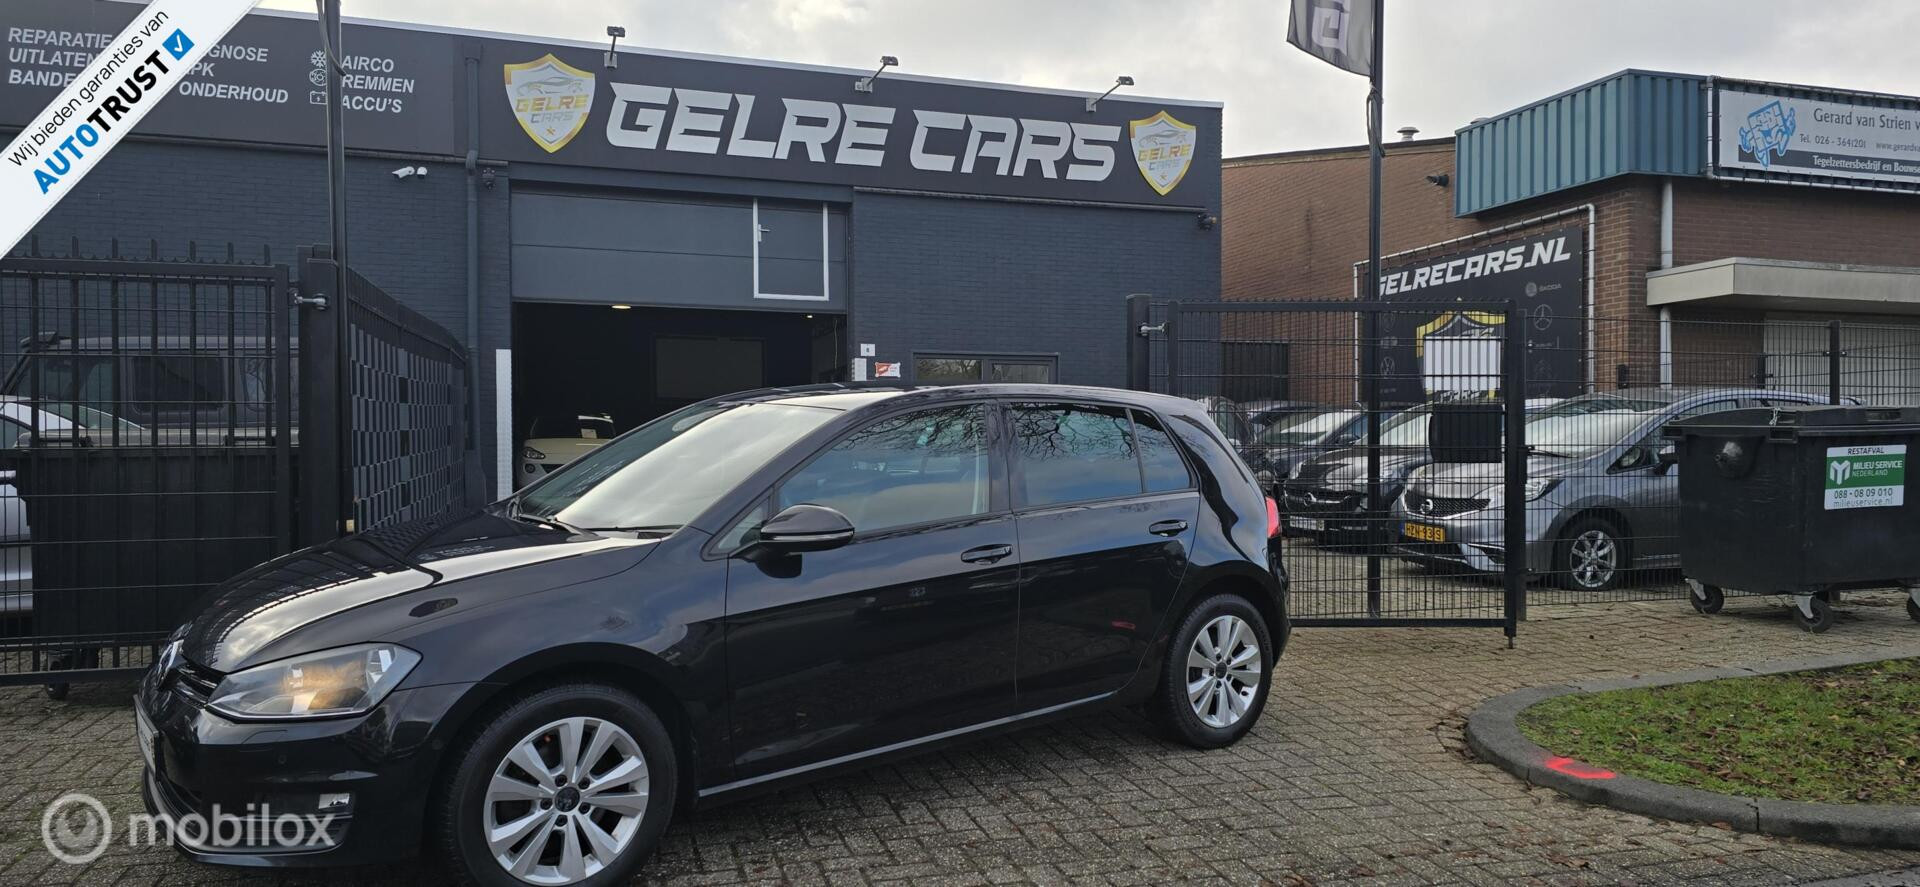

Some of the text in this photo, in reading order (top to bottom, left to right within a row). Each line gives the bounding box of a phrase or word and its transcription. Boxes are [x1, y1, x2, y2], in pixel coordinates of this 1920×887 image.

[341, 55, 395, 73] AIRCO
[342, 74, 415, 93] REMMEN
[179, 81, 289, 103] ONDERHOUD
[515, 94, 589, 112] GELRE
[531, 111, 574, 123] CARS
[1813, 108, 1853, 125] Gerard
[1856, 116, 1875, 127] van
[1879, 115, 1911, 130] Strien
[606, 82, 1122, 182] GELRE CARS
[1800, 134, 1812, 143] Tel.
[1814, 136, 1830, 145] 026
[1138, 145, 1191, 161] GELRE
[1812, 155, 1881, 172] Tegelzettersbedrijf
[1882, 163, 1892, 171] en
[1847, 447, 1885, 455] RESTAFVAL
[1853, 460, 1903, 469] MILIEU SERVICE
[1852, 469, 1888, 477] NEDERLAND
[1854, 489, 1864, 498] 08
[1866, 489, 1876, 497] 09
[1877, 488, 1893, 497] 010
